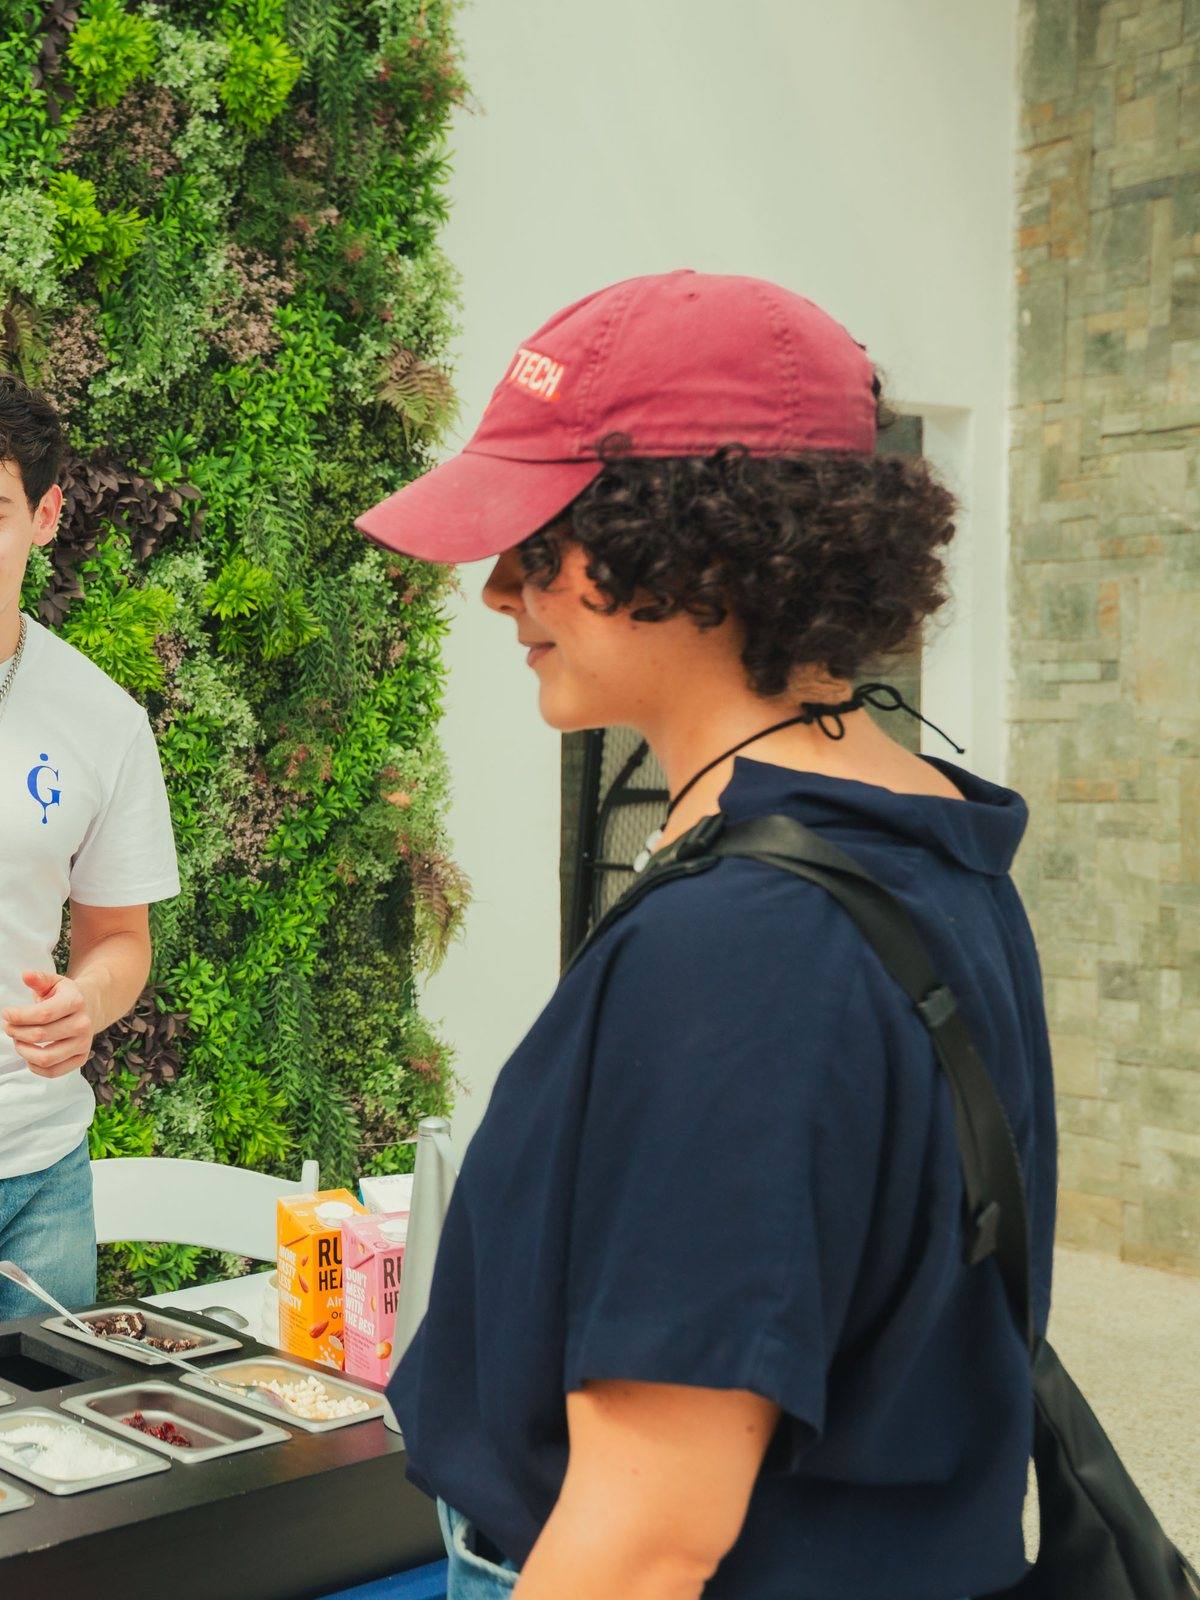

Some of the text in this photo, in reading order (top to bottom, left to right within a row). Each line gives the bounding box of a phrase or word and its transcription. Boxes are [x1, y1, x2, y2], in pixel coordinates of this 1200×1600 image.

[510, 349, 564, 397] TECH
[345, 1310, 374, 1337] THE BEST
